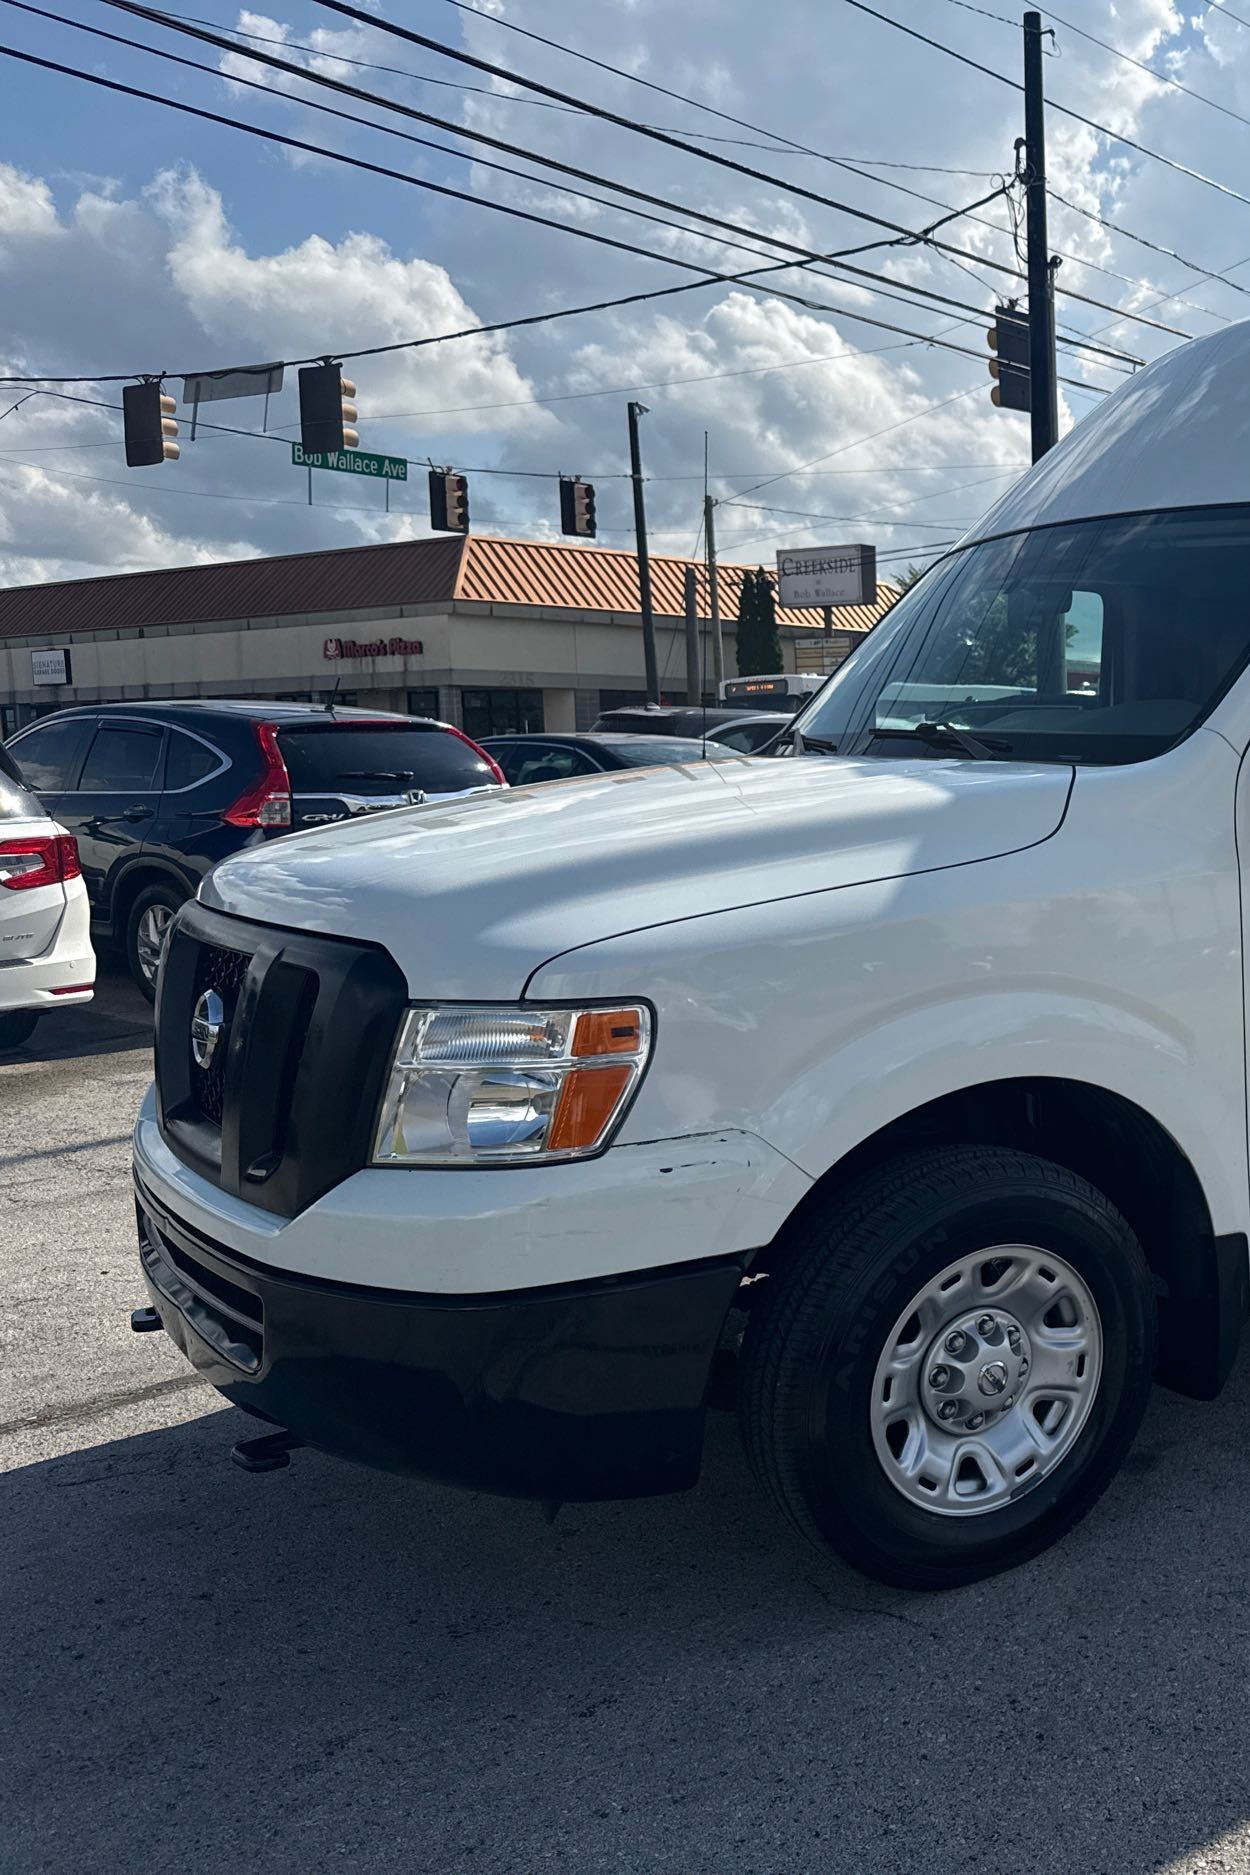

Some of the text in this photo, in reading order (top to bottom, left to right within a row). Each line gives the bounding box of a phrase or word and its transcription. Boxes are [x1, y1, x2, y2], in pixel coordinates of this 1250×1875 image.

[294, 445, 406, 477] Bob Wallace Ave
[782, 557, 856, 576] CREEKSIDE
[793, 587, 845, 599] Bob Wallace
[343, 637, 421, 657] Marco's Pizza
[301, 813, 345, 821] CR-V
